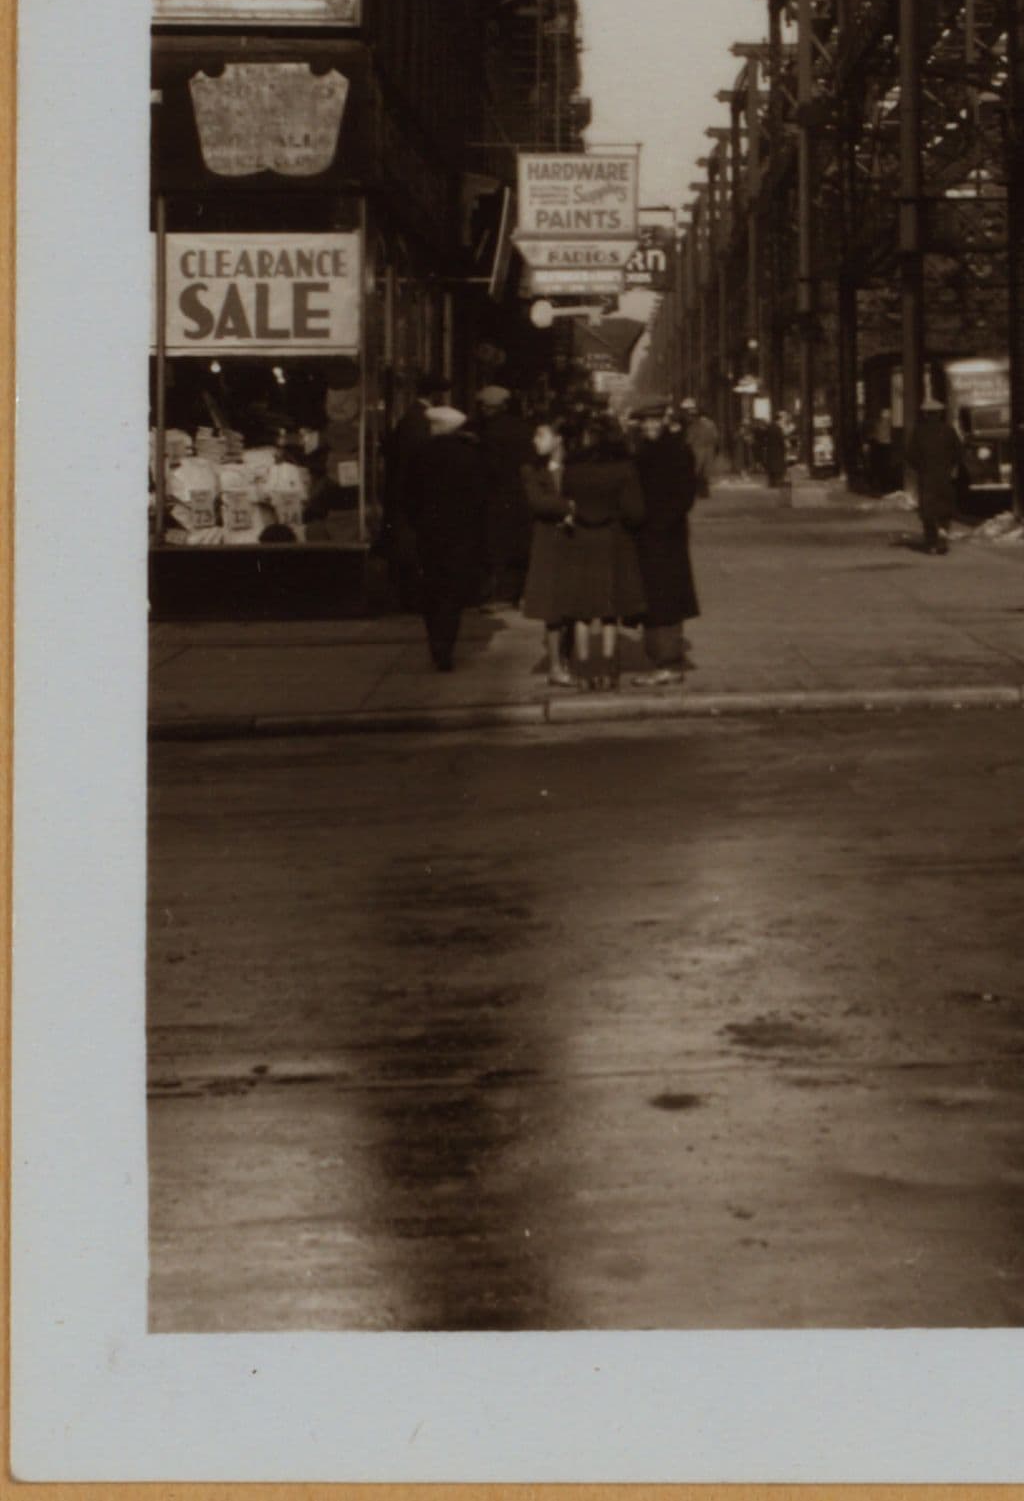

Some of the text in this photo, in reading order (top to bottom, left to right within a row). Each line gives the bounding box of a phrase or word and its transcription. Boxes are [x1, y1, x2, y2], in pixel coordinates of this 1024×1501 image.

[527, 162, 629, 181] HARDWARE
[535, 209, 622, 229] PAINTS
[179, 248, 347, 280] CLEARANCE
[547, 249, 620, 264] RADIOS
[179, 281, 331, 341] SALE
